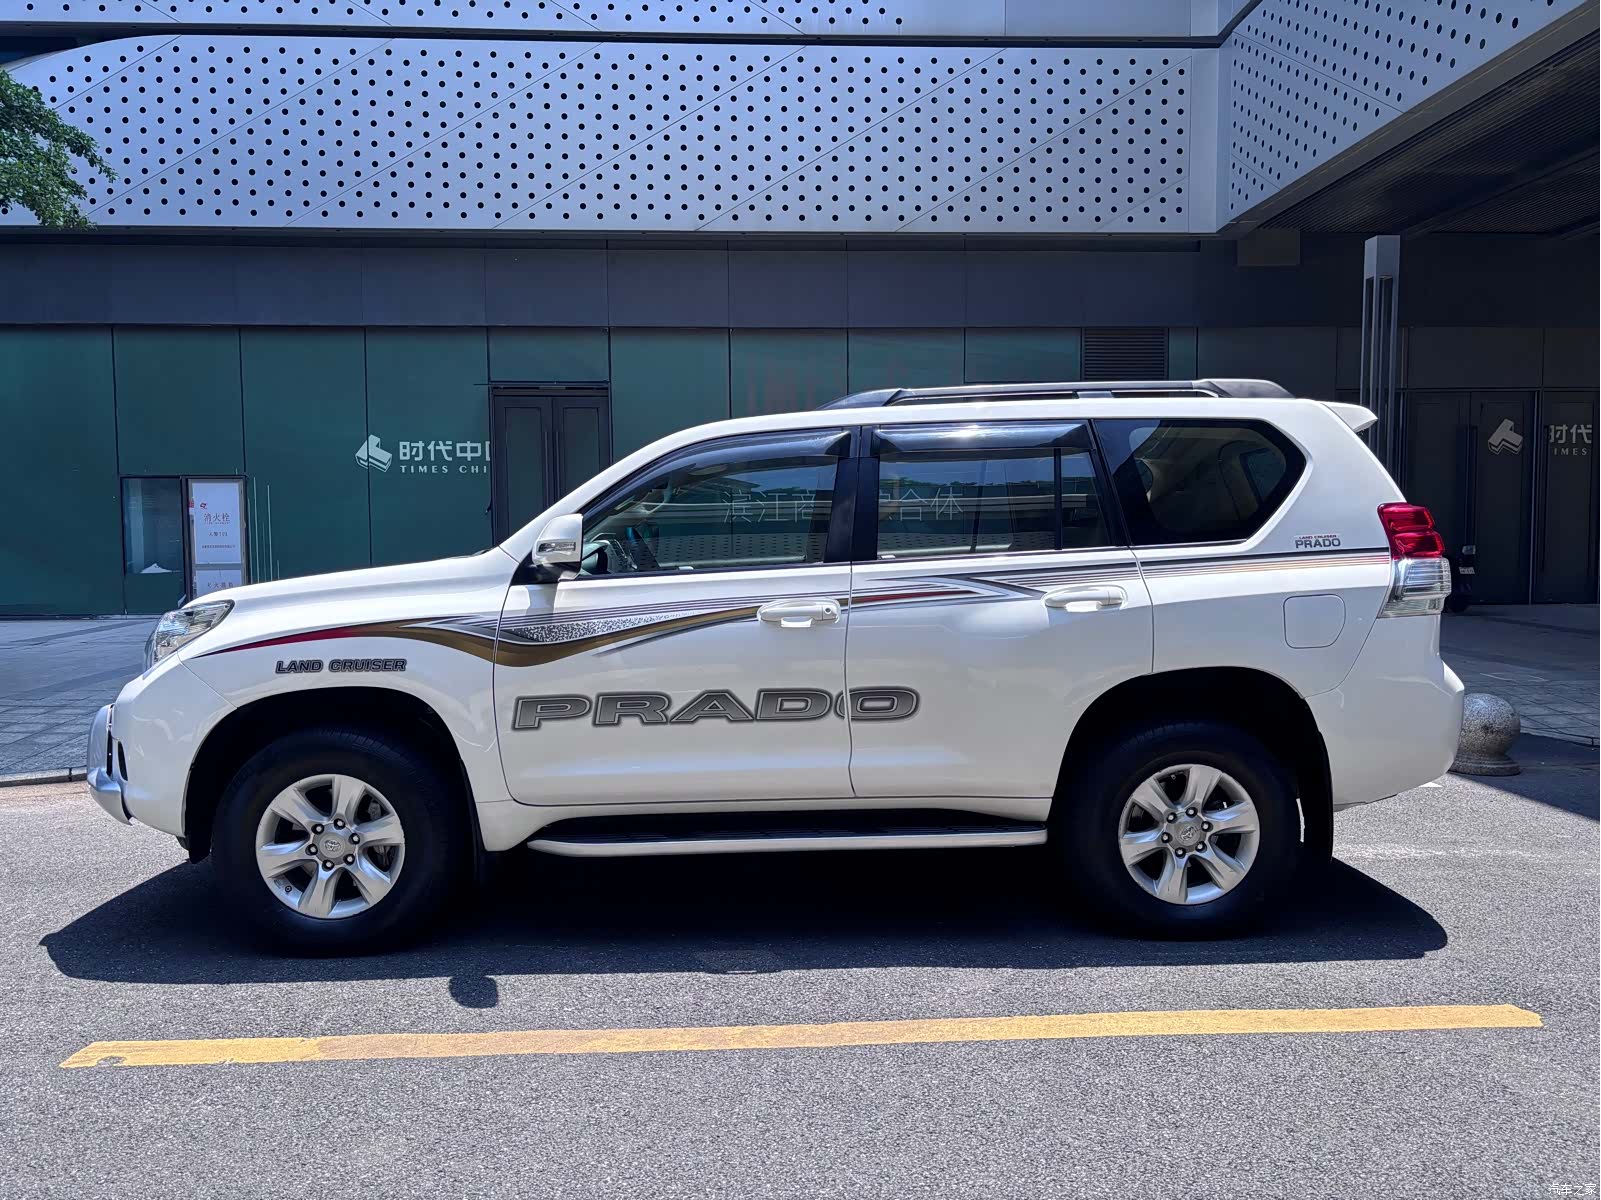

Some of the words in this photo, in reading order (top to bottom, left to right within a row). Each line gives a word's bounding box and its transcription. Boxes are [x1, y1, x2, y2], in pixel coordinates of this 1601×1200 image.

[1549, 424, 1592, 444] 时代
[399, 440, 490, 462] 时代中
[400, 465, 449, 474] TIMES
[459, 465, 487, 474] CHI
[1295, 538, 1341, 549] PRADO
[275, 659, 324, 674] LAND
[328, 658, 407, 673] CRUISER
[511, 685, 921, 731] PRADO
